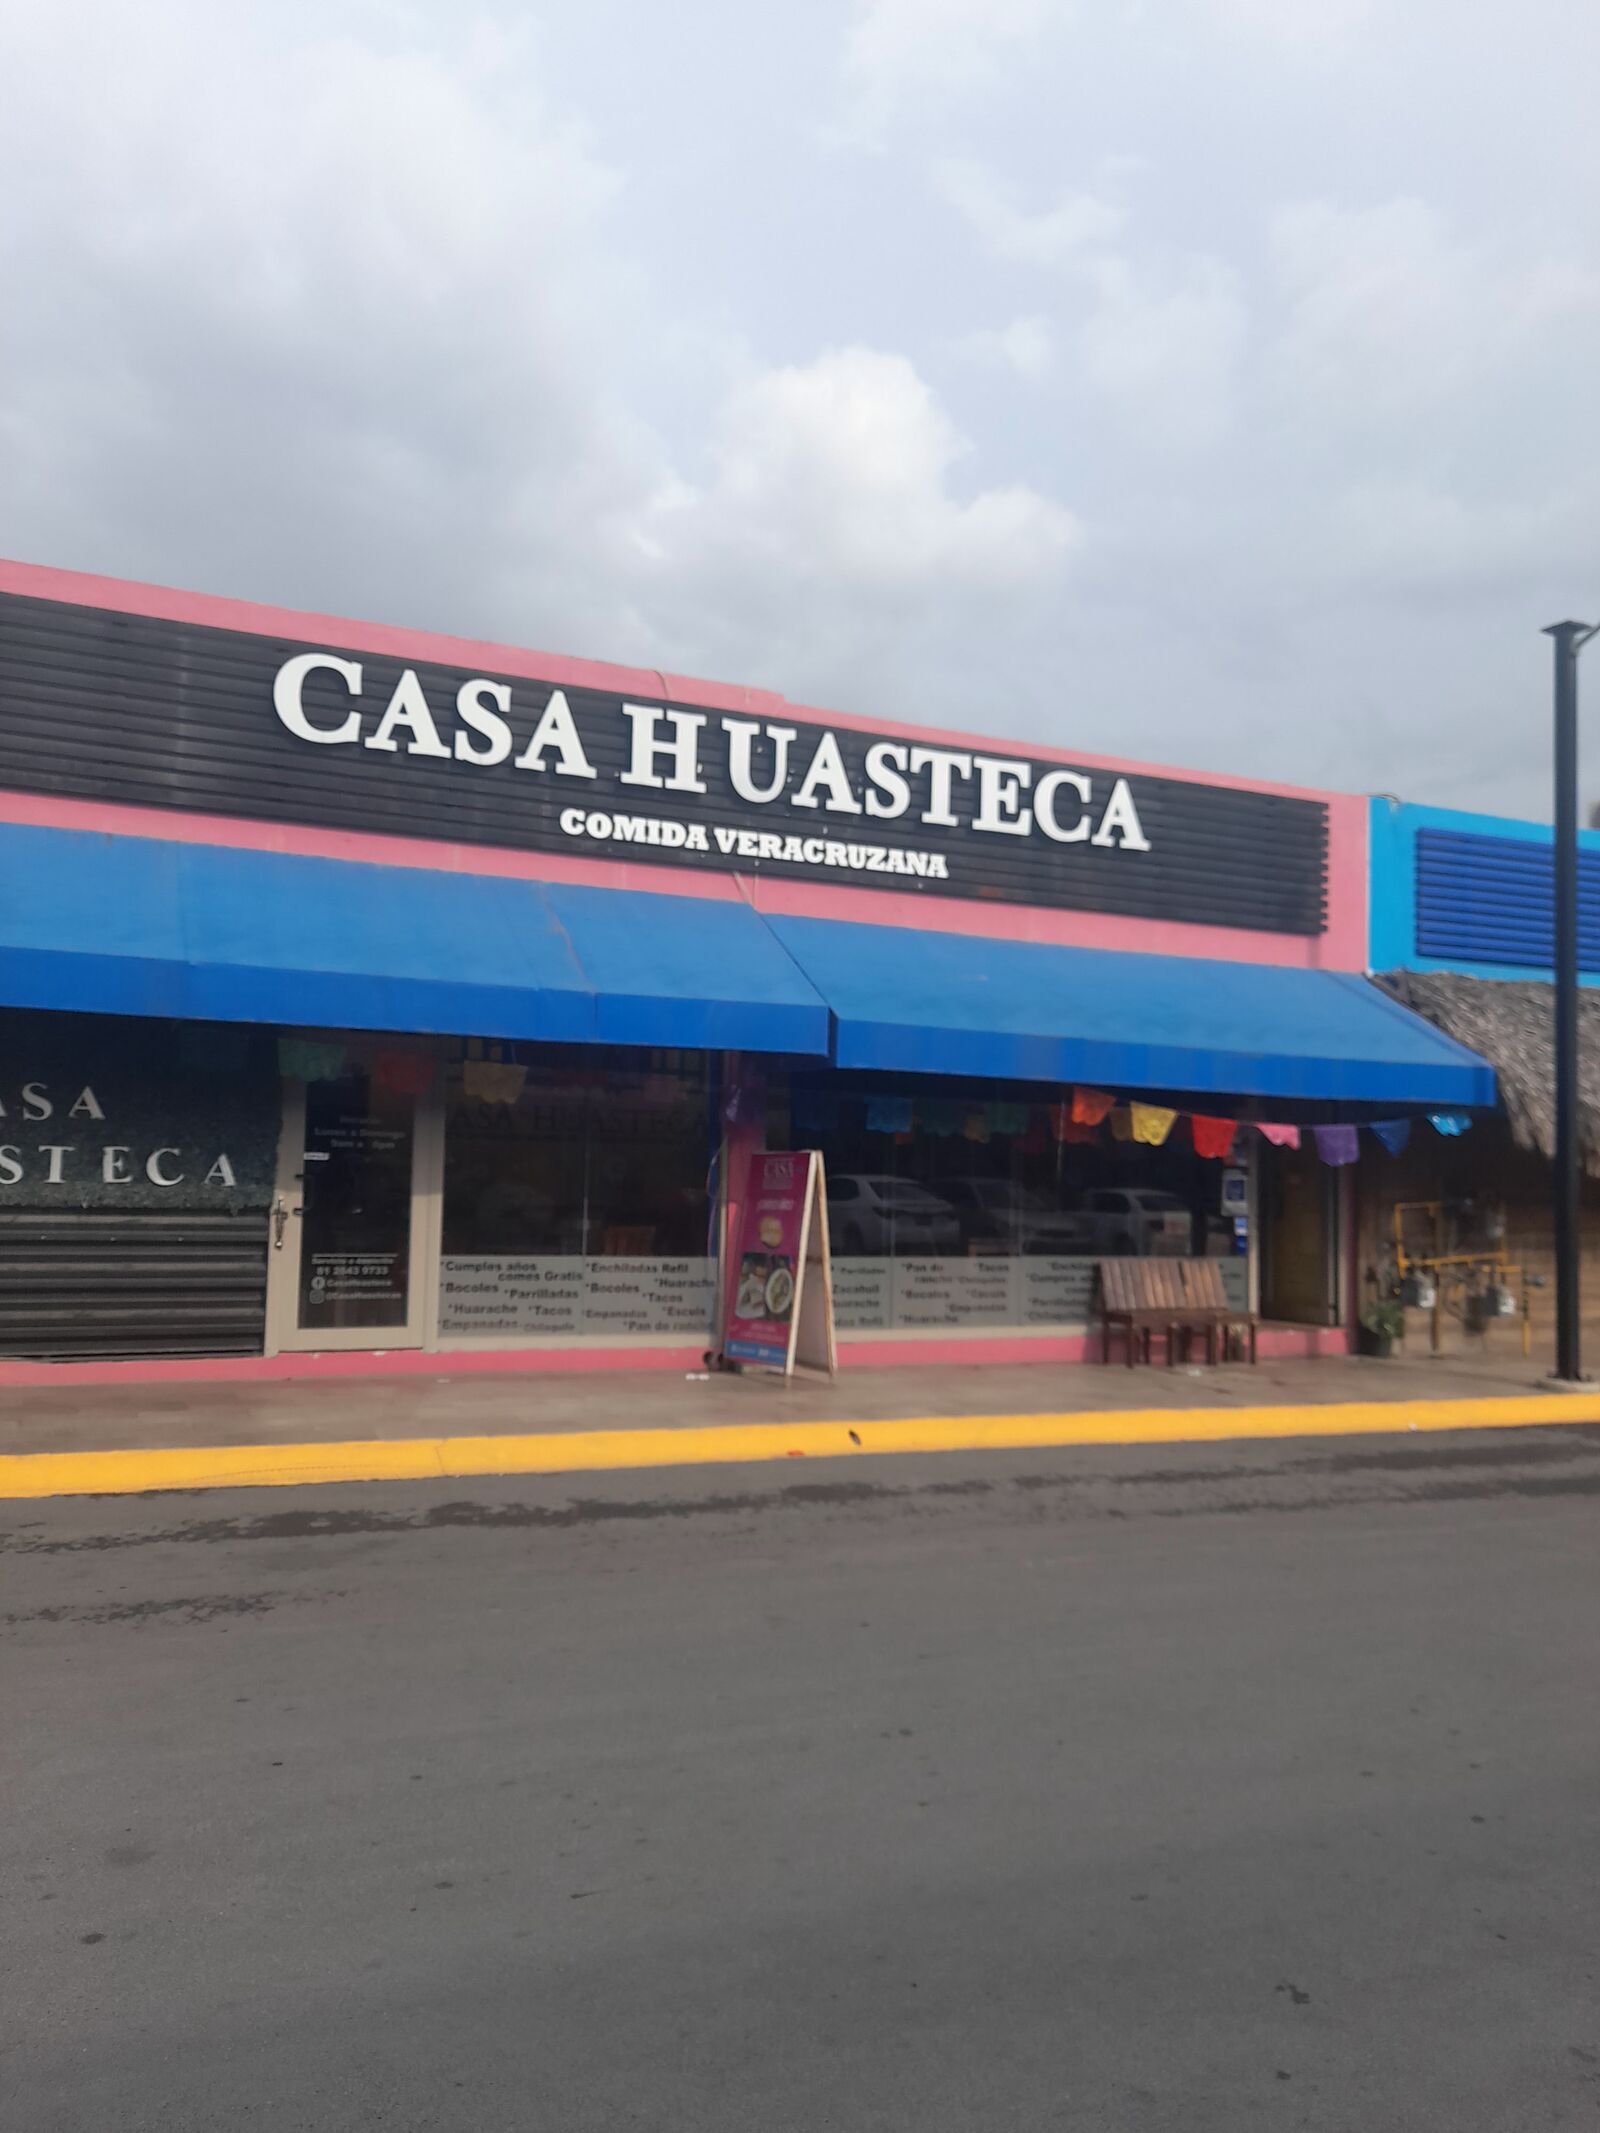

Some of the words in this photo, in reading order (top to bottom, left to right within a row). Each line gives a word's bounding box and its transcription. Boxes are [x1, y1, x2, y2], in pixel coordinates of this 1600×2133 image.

[273, 653, 597, 779] CASA
[620, 703, 1151, 851] HUASTECA
[560, 808, 709, 851] COMIDA
[713, 828, 949, 879] VERACRUZANA
